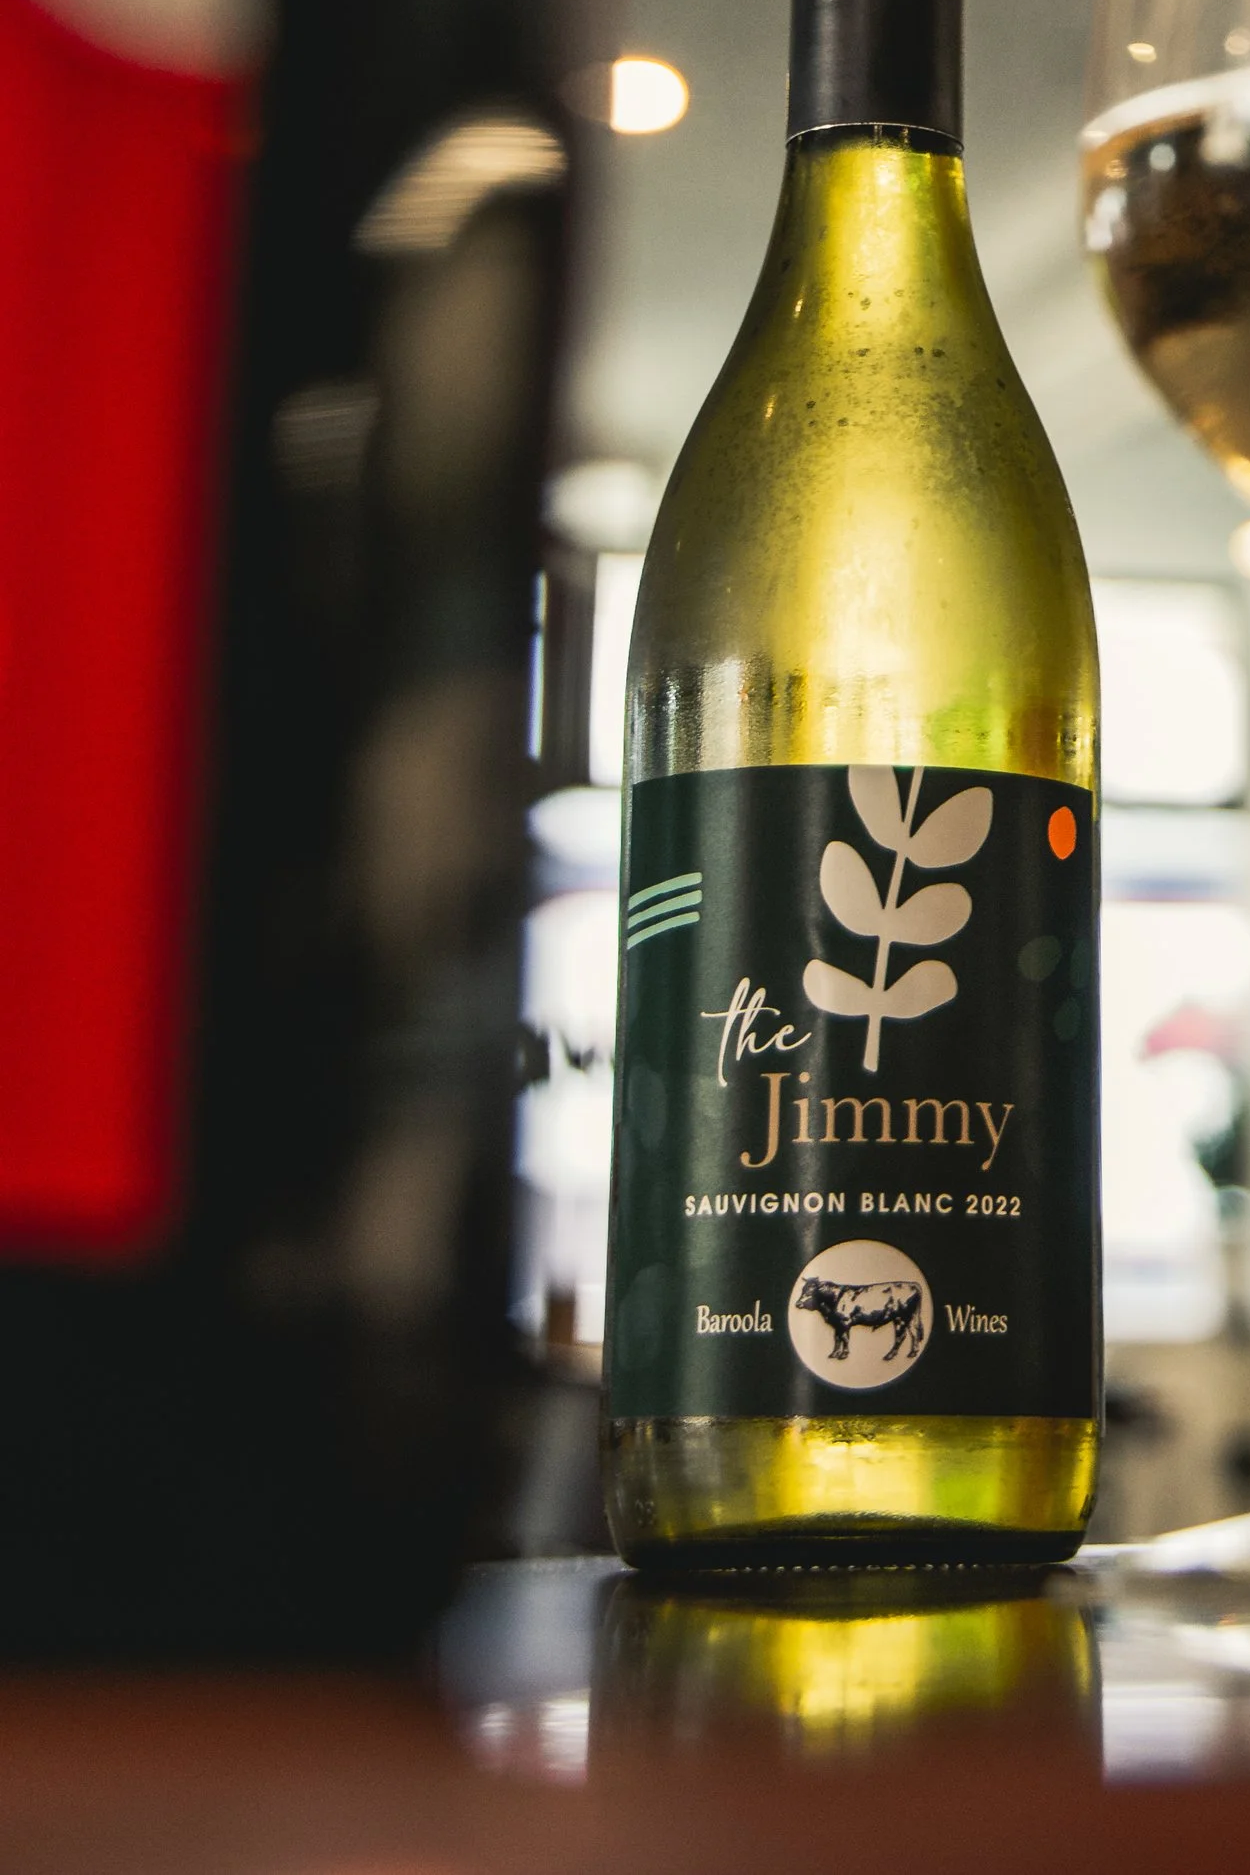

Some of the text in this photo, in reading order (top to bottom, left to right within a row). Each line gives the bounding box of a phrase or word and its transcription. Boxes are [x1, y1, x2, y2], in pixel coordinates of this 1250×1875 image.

[701, 976, 812, 1087] the
[739, 1071, 1015, 1171] Jimmy
[684, 1191, 1022, 1218] SAUVIGNON BLANC 2022
[695, 1299, 1008, 1335] Baroola Wines
